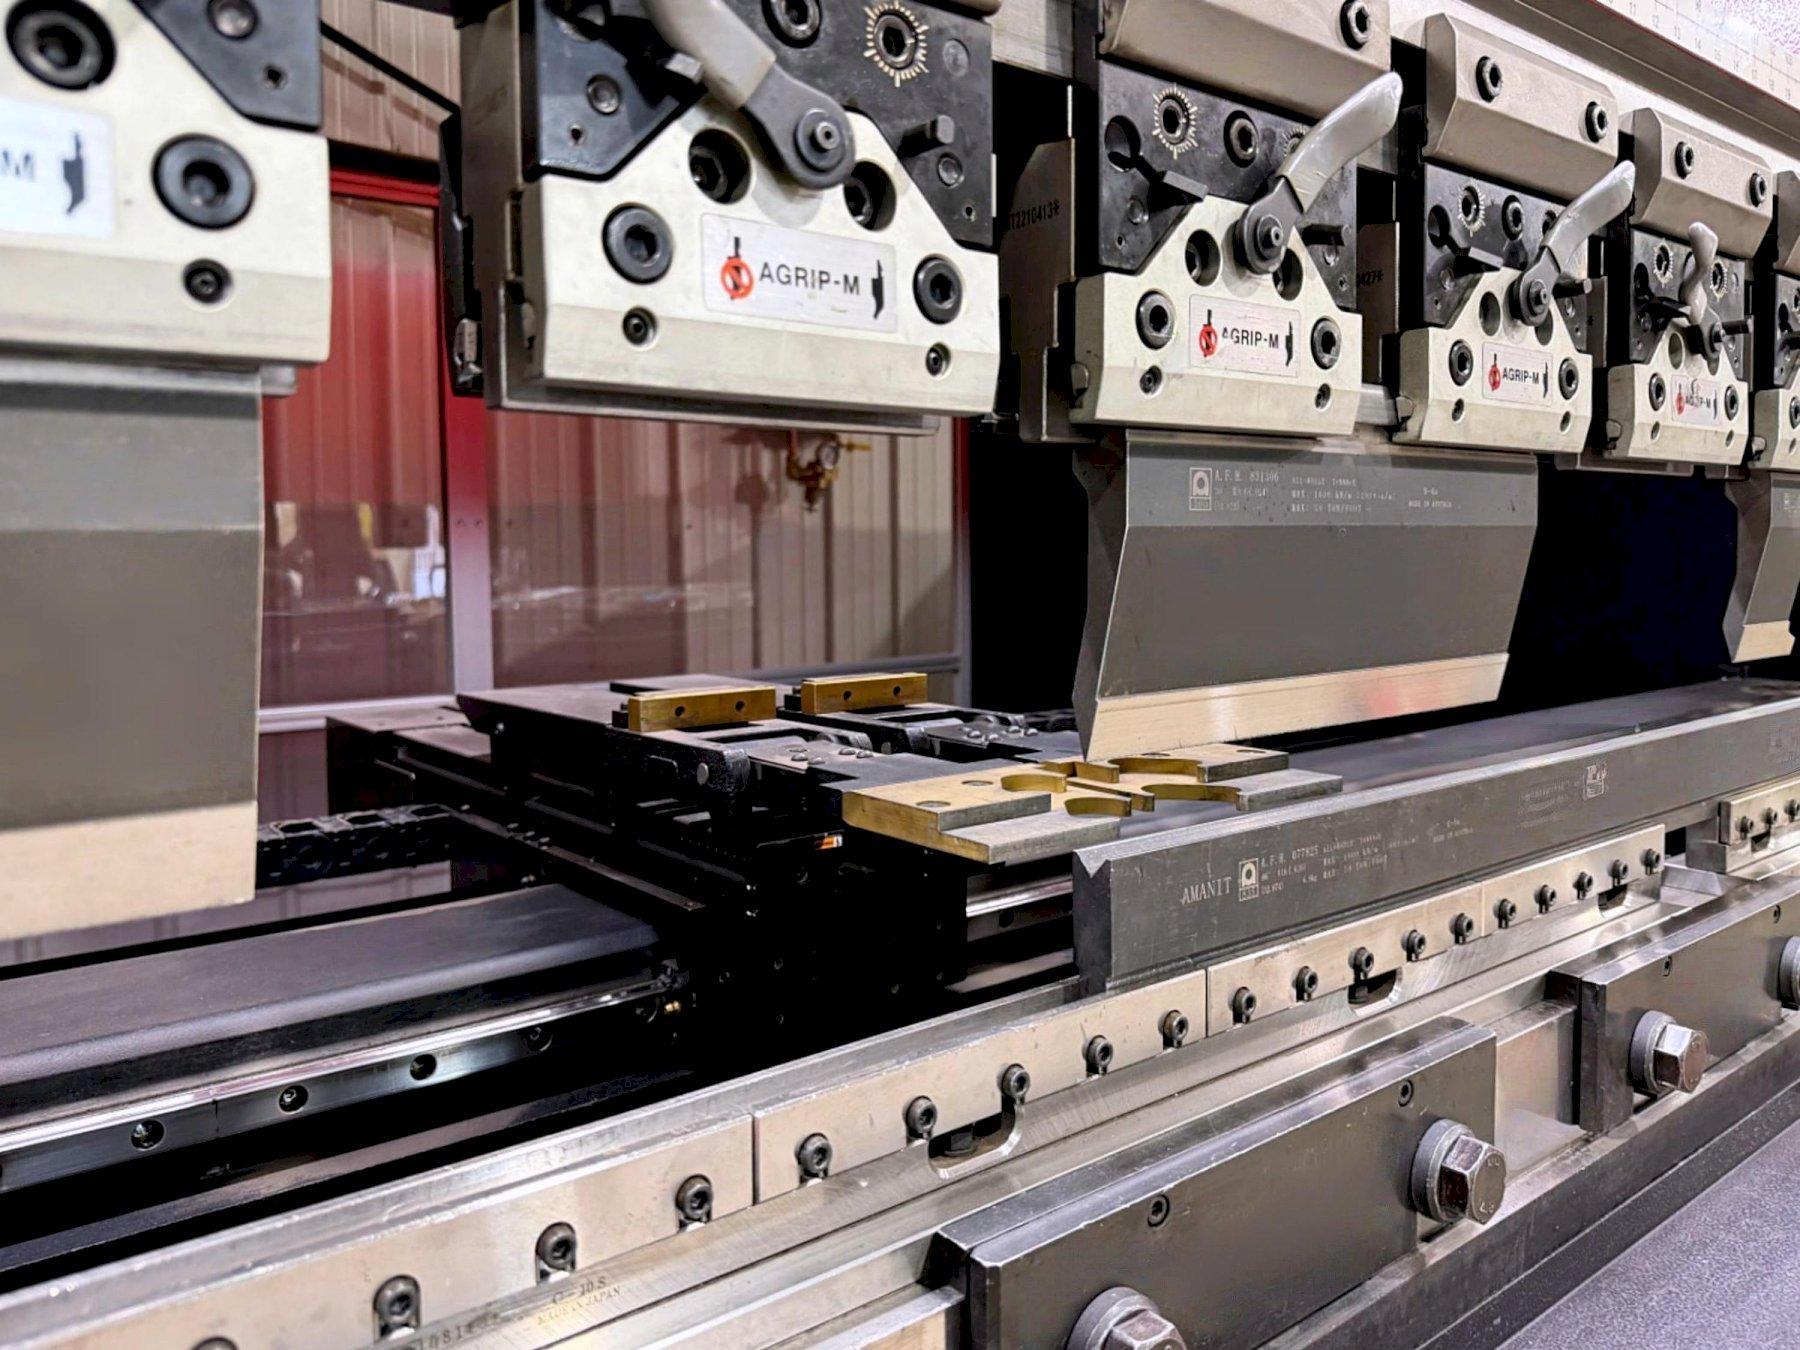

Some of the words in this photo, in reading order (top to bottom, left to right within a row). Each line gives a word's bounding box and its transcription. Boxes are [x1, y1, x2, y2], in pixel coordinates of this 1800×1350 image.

[760, 262, 860, 296] AGRIP-M
[1222, 326, 1279, 349] AGRIP-M
[1503, 367, 1539, 385] AGRIP-M
[1181, 877, 1232, 905] AMANIT
[587, 1285, 621, 1306] JAPAN
